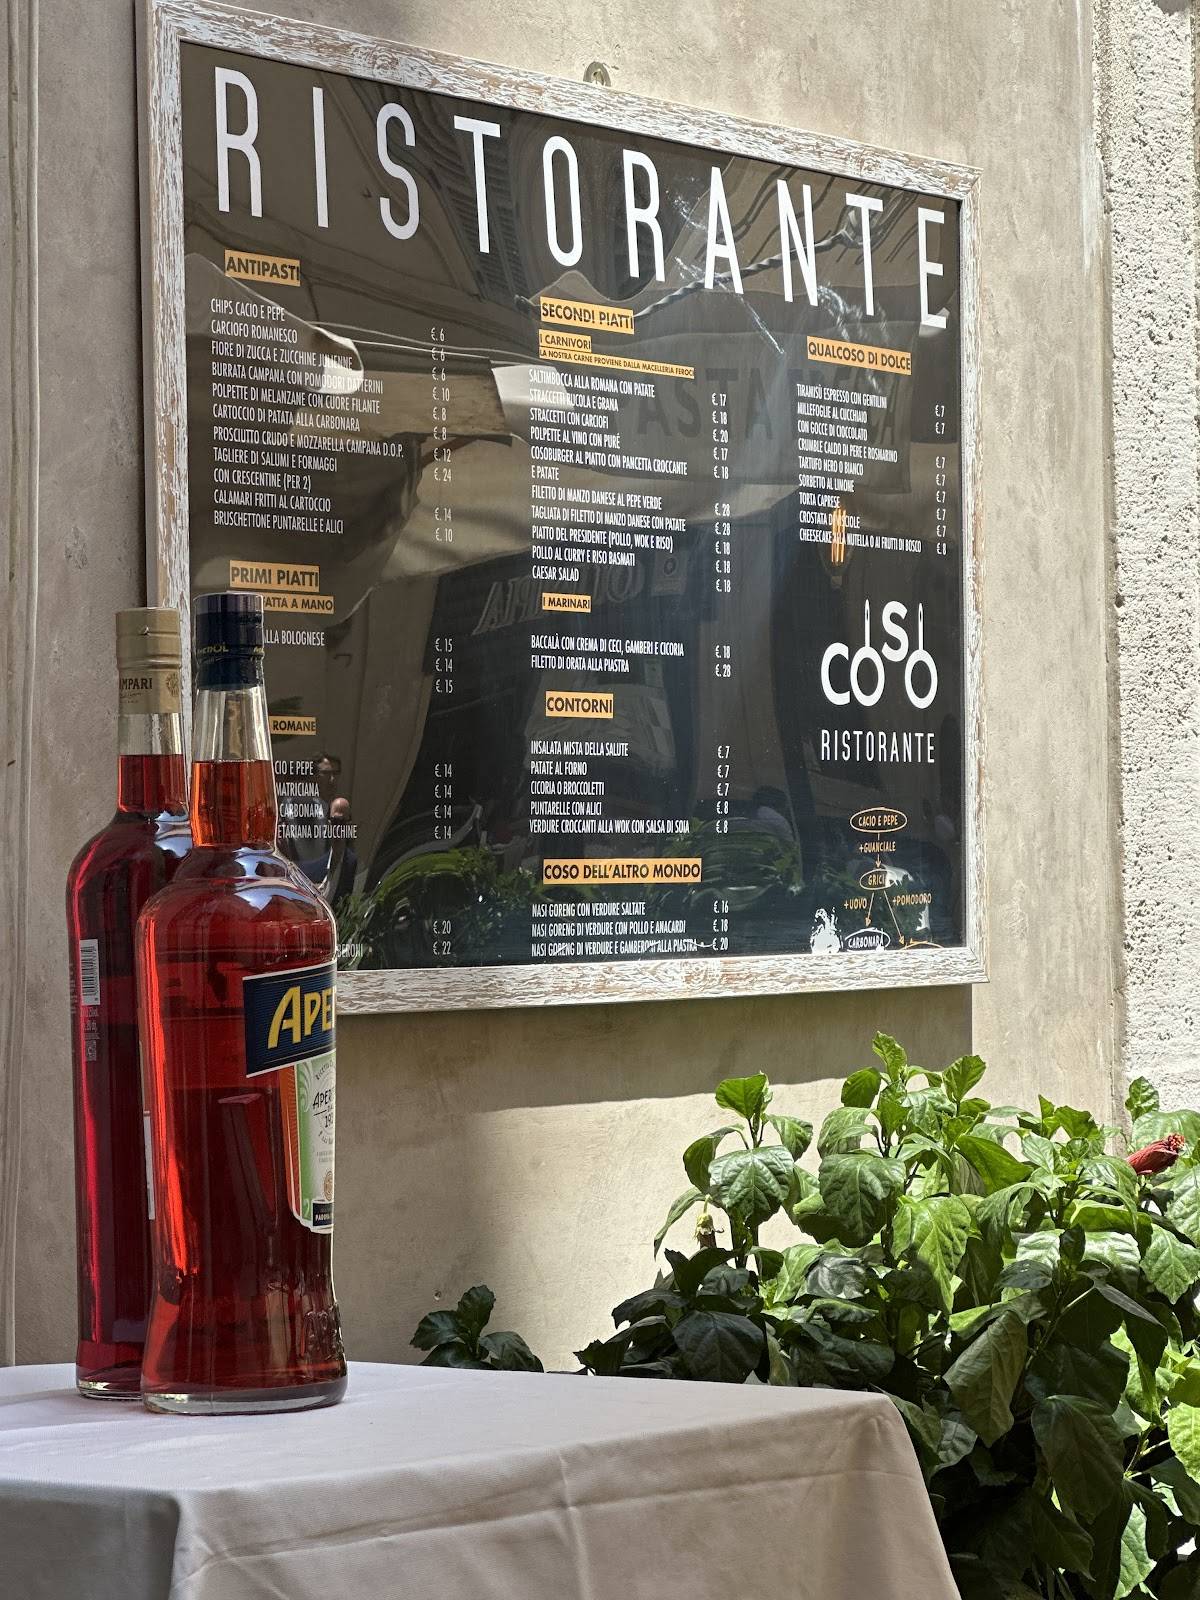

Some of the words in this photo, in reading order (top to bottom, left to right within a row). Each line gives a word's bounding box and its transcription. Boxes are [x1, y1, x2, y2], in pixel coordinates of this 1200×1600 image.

[213, 66, 949, 330] RISTORANTE
[226, 256, 299, 282] ANTIPASTI
[211, 299, 233, 315] CHIPS
[236, 302, 258, 318] CACIO
[260, 305, 265, 319] E
[267, 305, 285, 321] PEPE
[600, 311, 633, 330] PIATTI
[211, 320, 249, 338] CARCIOFO
[251, 325, 297, 344] ROMANESCO
[545, 335, 591, 350] CARNIVORI
[211, 341, 234, 357] FIORE
[237, 344, 244, 358] DI
[247, 345, 271, 360] ZUCCA
[274, 348, 278, 361] E
[280, 349, 316, 365] ZUCCHINE
[549, 351, 572, 361] NOSTRA
[574, 354, 592, 364] CARNE
[594, 357, 622, 367] PROVIENE
[624, 360, 640, 370] DALLA
[642, 362, 674, 374] MACELLERIA
[808, 342, 864, 364] QUALCOSO
[868, 352, 878, 366] DI
[882, 354, 911, 370] DOLCE
[212, 362, 246, 379] BURRATA
[249, 366, 285, 384] CAMPANA
[287, 371, 302, 385] CON
[305, 372, 345, 390] POMODORI
[213, 383, 249, 401] POLPETTE
[251, 387, 258, 402] DI
[261, 388, 306, 407] MELANZANE
[308, 393, 323, 408] CON
[325, 395, 350, 411] CUORE
[352, 398, 380, 414] FILANTE
[213, 404, 255, 422] CARTOCCIO
[258, 409, 265, 423] DI
[268, 410, 294, 425] PATATA
[296, 413, 314, 427] ALLA
[316, 415, 360, 432] CARBONARA
[530, 408, 565, 424] STRACCETTI
[567, 412, 580, 426] CON
[582, 413, 608, 429] CARCIOFI
[531, 427, 561, 443] POLPETTE
[563, 429, 570, 444] AL
[572, 430, 587, 446] VINO
[590, 431, 602, 447] CON
[604, 432, 620, 449] PURÉ
[810, 422, 828, 436] GOCCE
[213, 426, 260, 445] PROSCIUTTO
[262, 431, 288, 447] CRUDO
[290, 433, 294, 448] E
[297, 434, 344, 452] MOZZARELLA
[346, 438, 381, 456] CAMPANA
[383, 442, 404, 458] D.O.P.
[213, 447, 248, 464] TAGLIERE
[251, 450, 259, 465] DI
[261, 451, 289, 468] SALUMI
[292, 454, 296, 468] E
[298, 455, 337, 472] FORMAGGI
[214, 468, 230, 484] CON
[232, 470, 281, 489] CRESCENTINE
[283, 474, 301, 492] (PER
[303, 476, 311, 493] 2)
[531, 466, 535, 478] E
[537, 466, 559, 480] PATATE
[214, 490, 253, 506] CALAMARI
[255, 493, 276, 508] FRITTI
[279, 495, 288, 509] AL
[290, 495, 331, 512] CARTOCCIO
[214, 511, 271, 529] BRUSCHETTONE
[273, 515, 318, 532] PUNTARELLE
[320, 519, 324, 533] E
[326, 519, 344, 534] ALICI
[532, 546, 553, 560] POLLO
[555, 548, 563, 560] AL
[565, 548, 584, 562] CURRY
[587, 550, 590, 563] E
[592, 550, 607, 564] RISO
[231, 567, 272, 585] PRIMI
[277, 570, 319, 587] PIATTI
[532, 566, 557, 580] CAESAR
[559, 567, 579, 581] SALAD
[291, 598, 298, 609] A
[302, 599, 333, 611] MANO
[548, 597, 590, 609] MARINARI
[281, 630, 325, 646] BOLOGNESE
[821, 598, 938, 709] COSO
[531, 655, 556, 669] FILETTO
[558, 657, 564, 670] DI
[566, 657, 587, 671] ORATA
[588, 658, 602, 671] ALLA
[604, 659, 629, 672] PIASTRA
[119, 677, 152, 690] MPARI
[546, 697, 612, 714] CONTORNI
[273, 720, 316, 732] ROMANE
[531, 741, 561, 755] INSALATA
[564, 742, 583, 756] MISTA
[585, 742, 604, 756] DELLA
[606, 742, 628, 757] SALUTE
[821, 729, 935, 763] RISTORANTE
[530, 761, 553, 775] PATATE
[555, 762, 563, 775] AL
[565, 762, 587, 776] FORNO
[531, 781, 555, 795] CICORIA
[557, 781, 562, 795] O
[564, 782, 604, 796] BROCCOLETTI
[280, 803, 324, 818] CARBONARA
[530, 802, 570, 815] PUNTARELLE
[572, 802, 584, 815] CON
[586, 802, 601, 816] ALICI
[859, 816, 876, 826] CACIO
[878, 815, 881, 826] E
[884, 815, 898, 825] PEPE
[544, 864, 579, 879] COSO
[653, 864, 700, 878] MONDO
[532, 904, 547, 917] NASI
[549, 904, 575, 917] GORENG
[577, 903, 590, 917] CON
[592, 903, 620, 916] VERDURE
[621, 902, 645, 916] SALTATE
[268, 985, 336, 1049] APE
